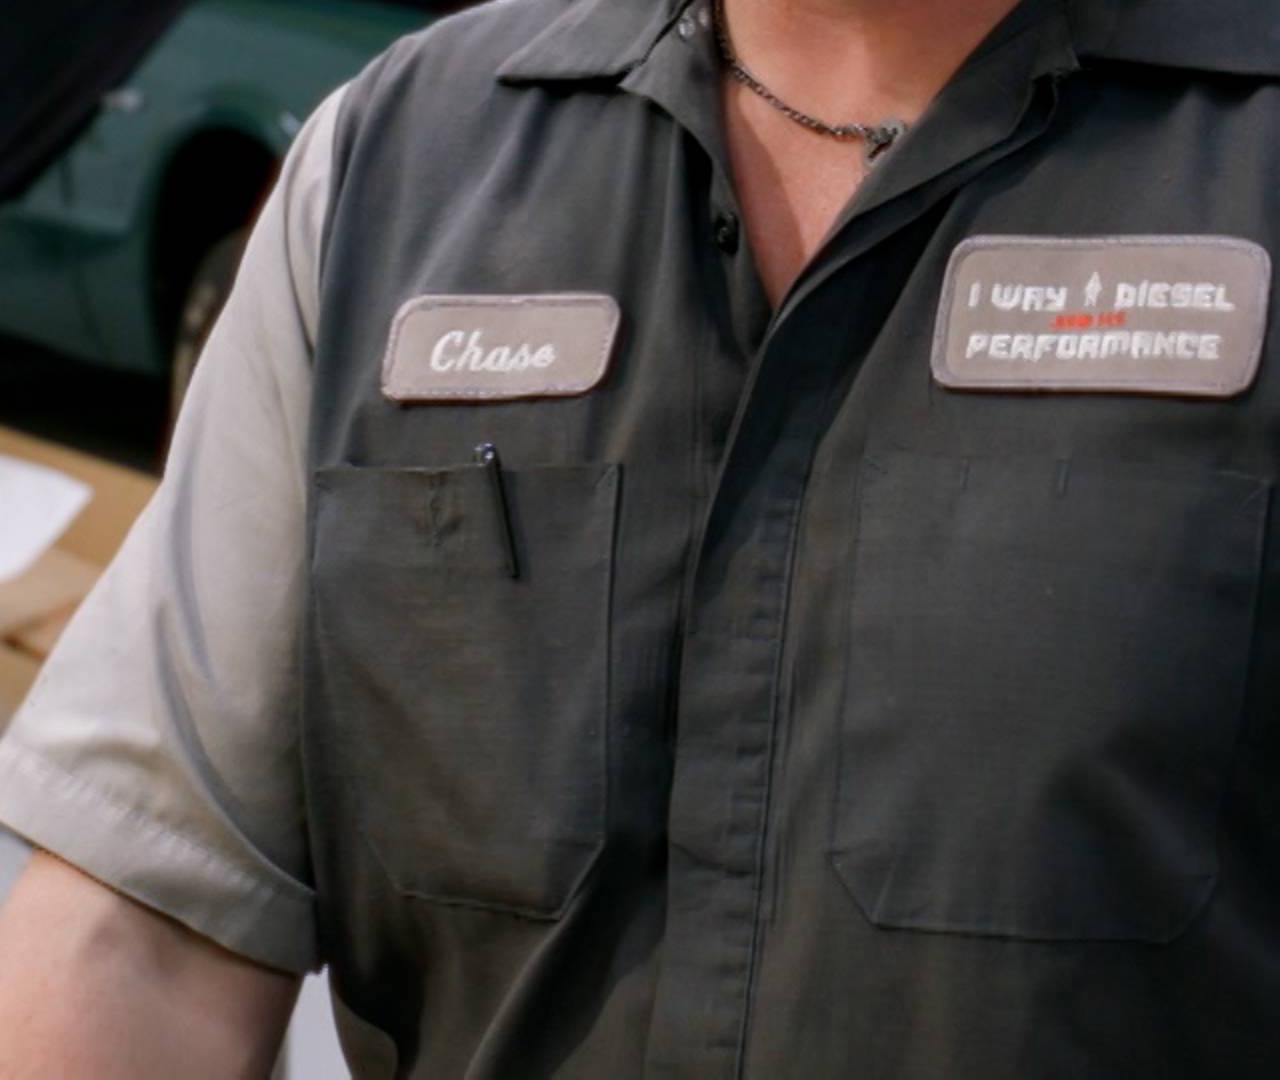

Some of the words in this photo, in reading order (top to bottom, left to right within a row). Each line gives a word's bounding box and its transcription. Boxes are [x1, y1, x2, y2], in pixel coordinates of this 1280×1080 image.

[968, 279, 982, 308] I
[990, 282, 1068, 312] WAY
[1114, 278, 1236, 311] DIESEL
[429, 328, 557, 373] Chase
[965, 330, 1221, 362] PERFORMANCE
